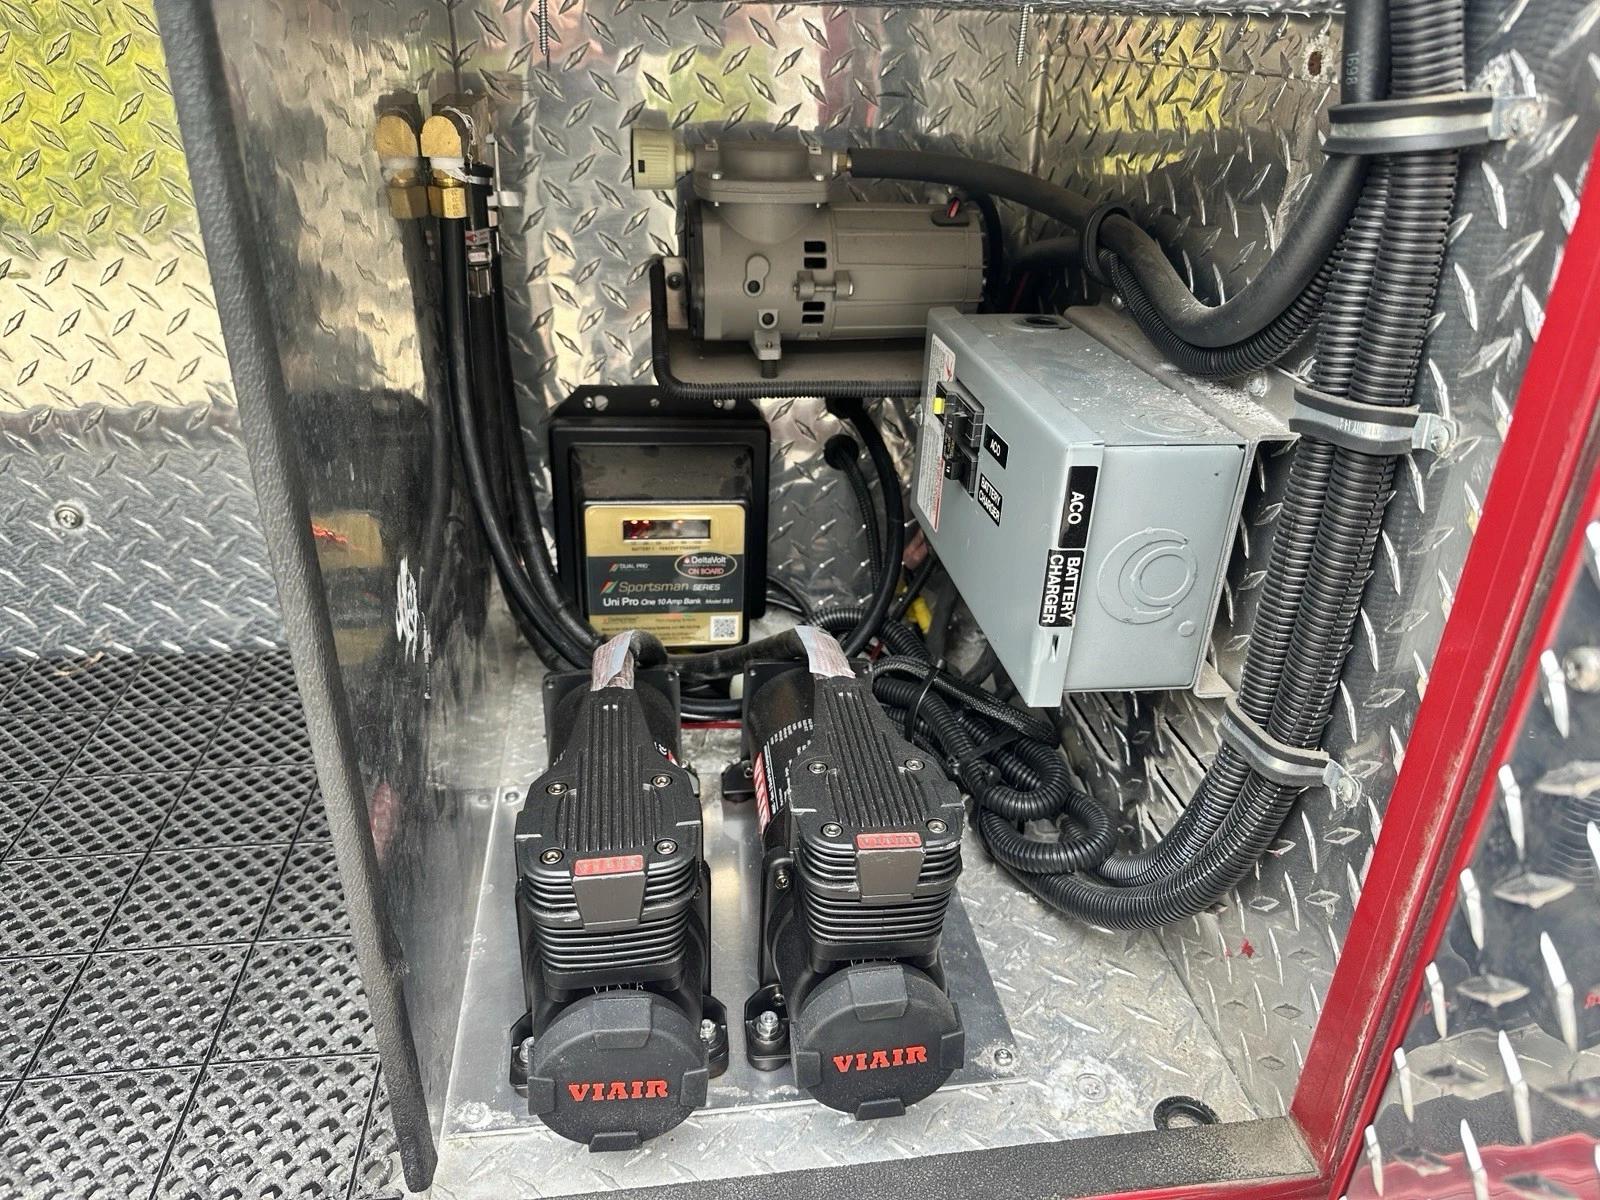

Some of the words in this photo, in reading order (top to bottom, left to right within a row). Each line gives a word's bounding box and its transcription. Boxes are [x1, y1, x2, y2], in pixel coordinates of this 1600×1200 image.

[990, 439, 1001, 456] ACO
[981, 476, 1001, 506] BATTERY
[979, 489, 1000, 522] CHARGER
[1067, 491, 1085, 525] ACO
[687, 567, 700, 575] ON
[700, 567, 725, 575] BOARD
[690, 556, 726, 564] DeltaVolt
[618, 581, 689, 595] Sportsman
[692, 583, 721, 591] SERIES
[1042, 554, 1064, 624] CHARGER
[1060, 556, 1081, 620] BATTERY
[603, 598, 620, 607] Uni
[621, 597, 640, 607] Pro
[666, 598, 683, 607] Amp
[832, 1045, 928, 1073] VIAIR
[568, 1080, 668, 1102] VIAIR
